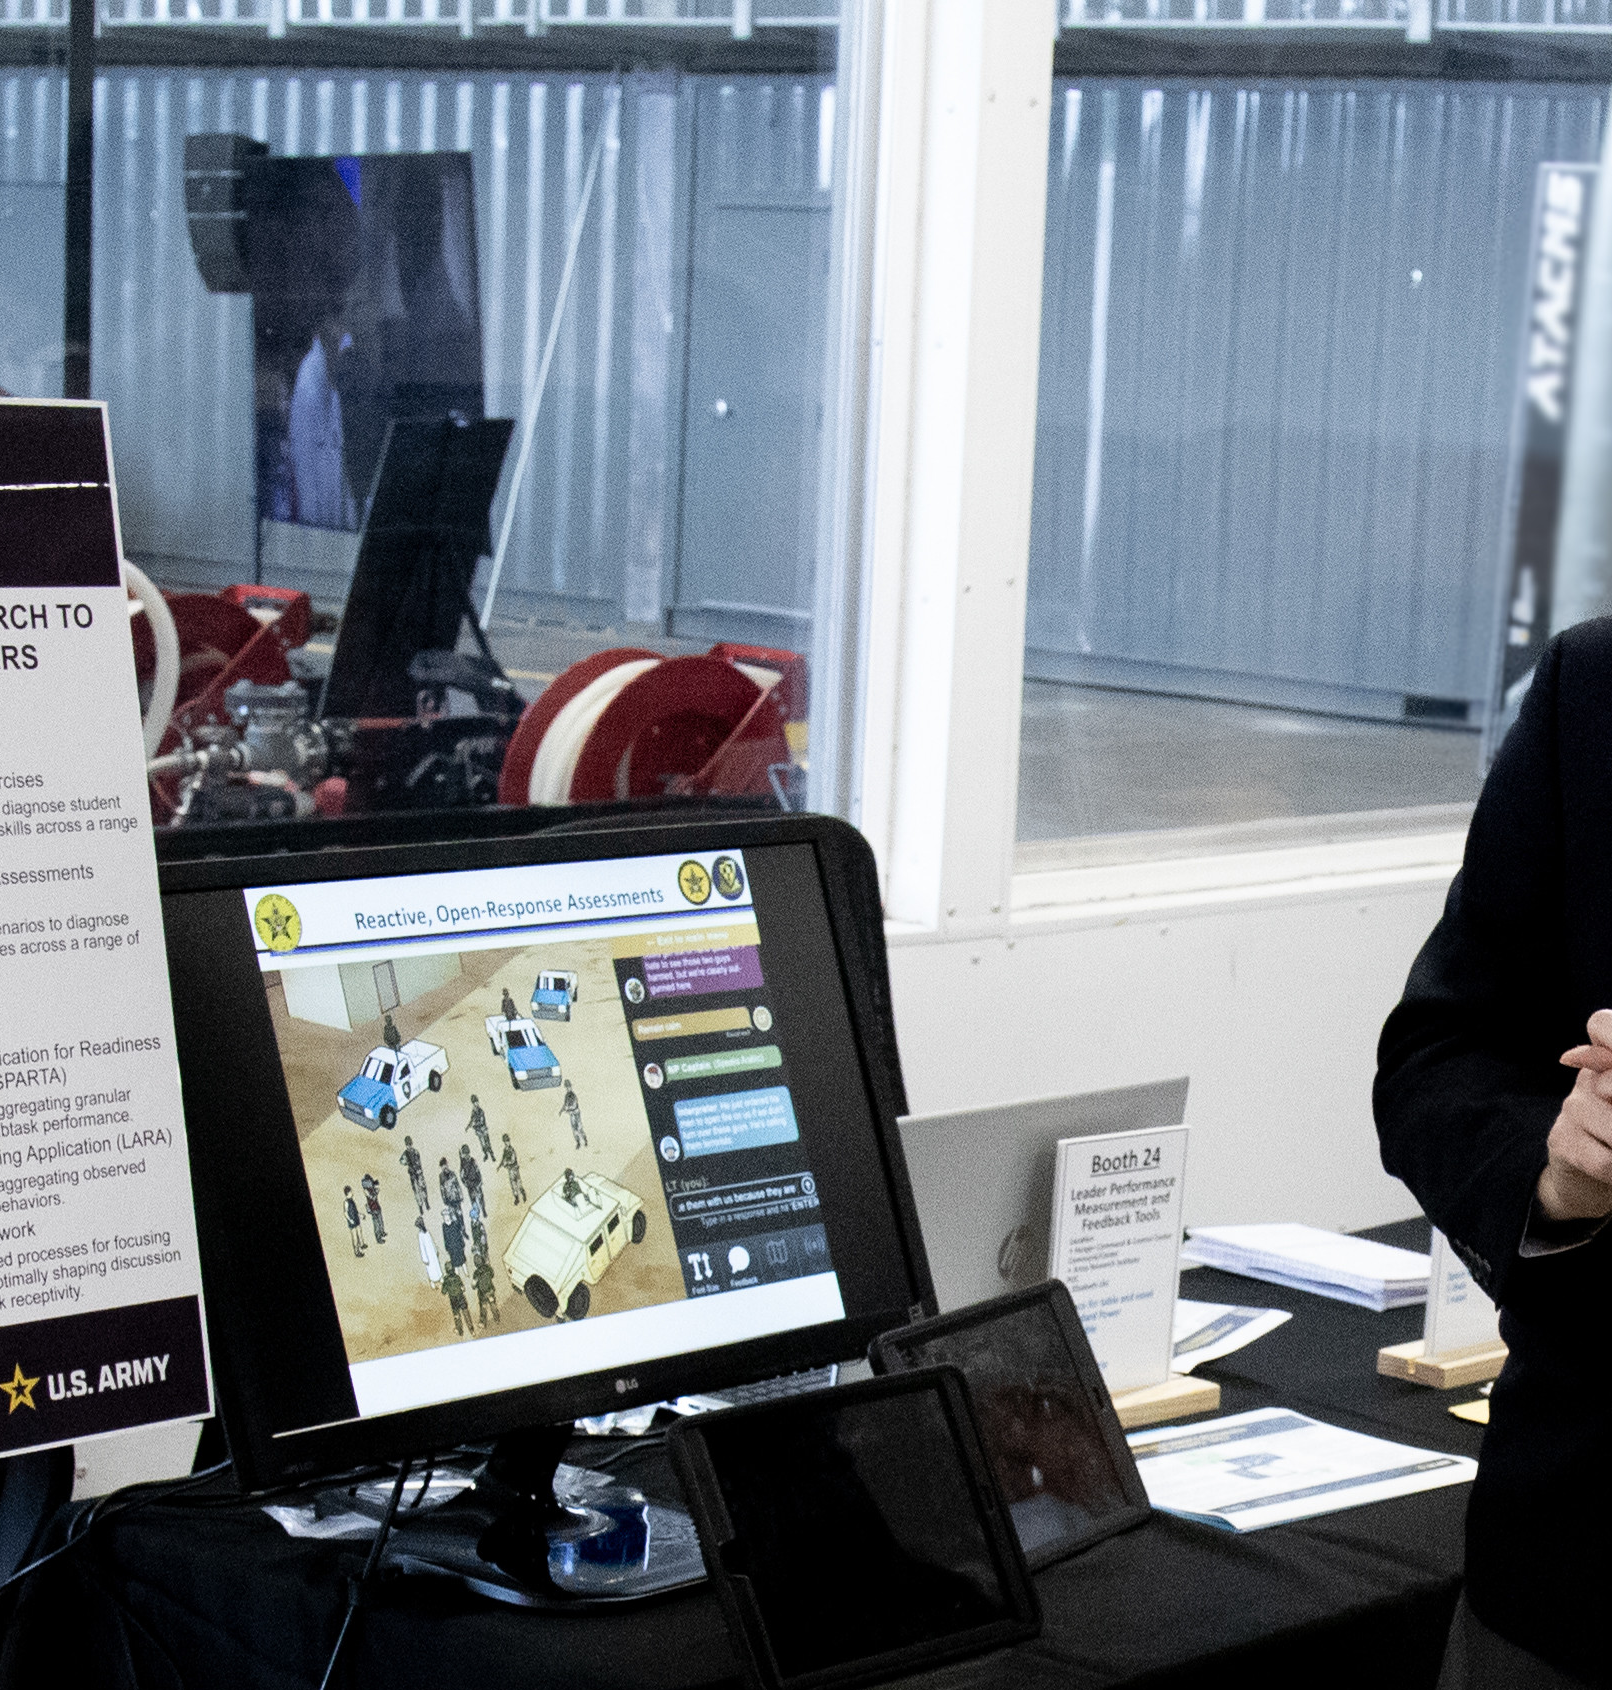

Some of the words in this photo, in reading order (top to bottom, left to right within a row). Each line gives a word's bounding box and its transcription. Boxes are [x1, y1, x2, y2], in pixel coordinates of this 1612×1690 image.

[55, 603, 93, 628] TO
[353, 907, 432, 929] Reactive,
[435, 898, 562, 925] Open-Response
[567, 887, 664, 910] Assessments
[19, 938, 66, 954] across
[70, 937, 79, 950] a
[83, 934, 122, 951] range
[126, 928, 139, 945] of
[1091, 1151, 1138, 1174] Booth
[1142, 1146, 1160, 1167] 24
[1071, 1186, 1107, 1202] Leader
[1109, 1176, 1177, 1197] Performance
[1074, 1196, 1149, 1216] Measurement
[1150, 1191, 1171, 1205] and
[1081, 1211, 1130, 1230] Feedback
[1134, 1207, 1160, 1223] Tools
[10, 1284, 83, 1307] receptivity.
[48, 1369, 93, 1400] U.S.
[98, 1353, 170, 1392] ARMY
